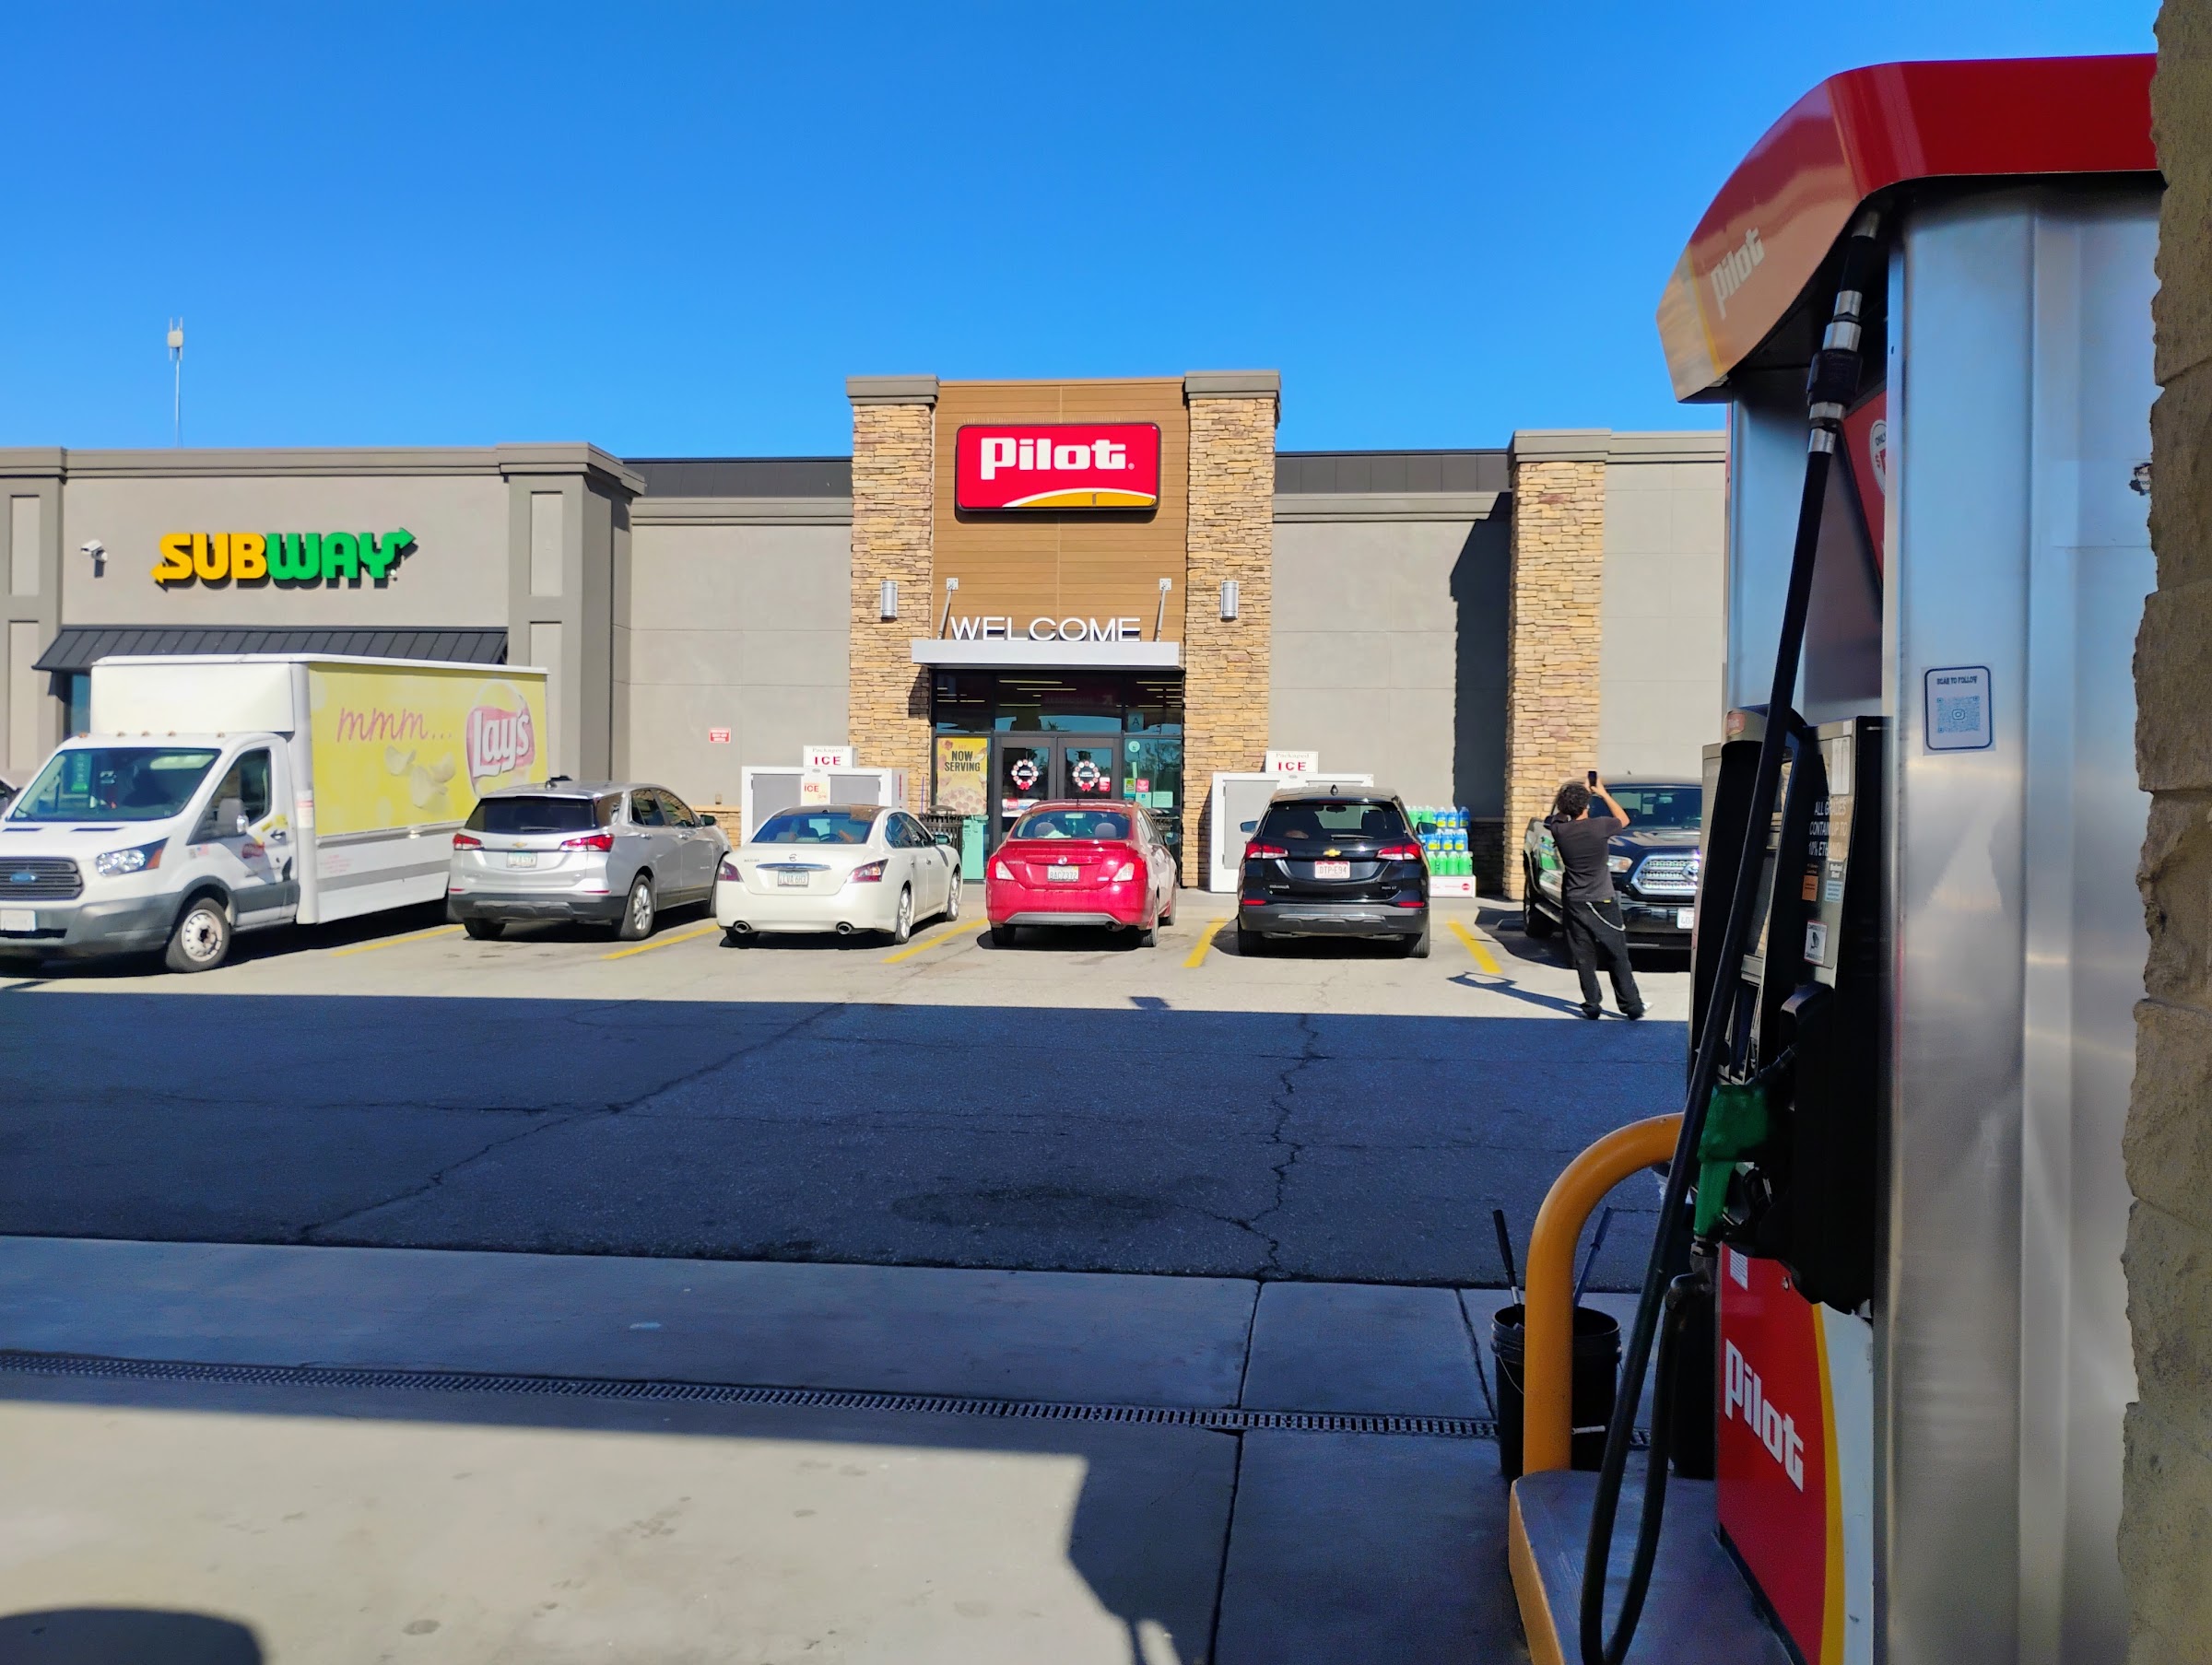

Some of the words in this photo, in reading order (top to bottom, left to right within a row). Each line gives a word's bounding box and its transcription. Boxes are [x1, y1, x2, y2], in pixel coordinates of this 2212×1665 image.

[980, 437, 1126, 480] Pilot
[150, 527, 416, 583] SUBWAY
[950, 616, 1141, 642] WELCOME
[1958, 675, 1978, 684] FOLLOW
[1132, 717, 1140, 726] A
[473, 709, 530, 779] Lay's
[815, 756, 841, 767] ICE
[951, 750, 973, 762] NOW
[944, 761, 981, 772] SERVING
[1278, 761, 1307, 772] ICE
[804, 785, 819, 793] ICE
[1814, 802, 1824, 815] ALL
[1830, 822, 1839, 836] UP
[1840, 822, 1848, 836] TO
[1724, 1338, 1804, 1493] Pilot
